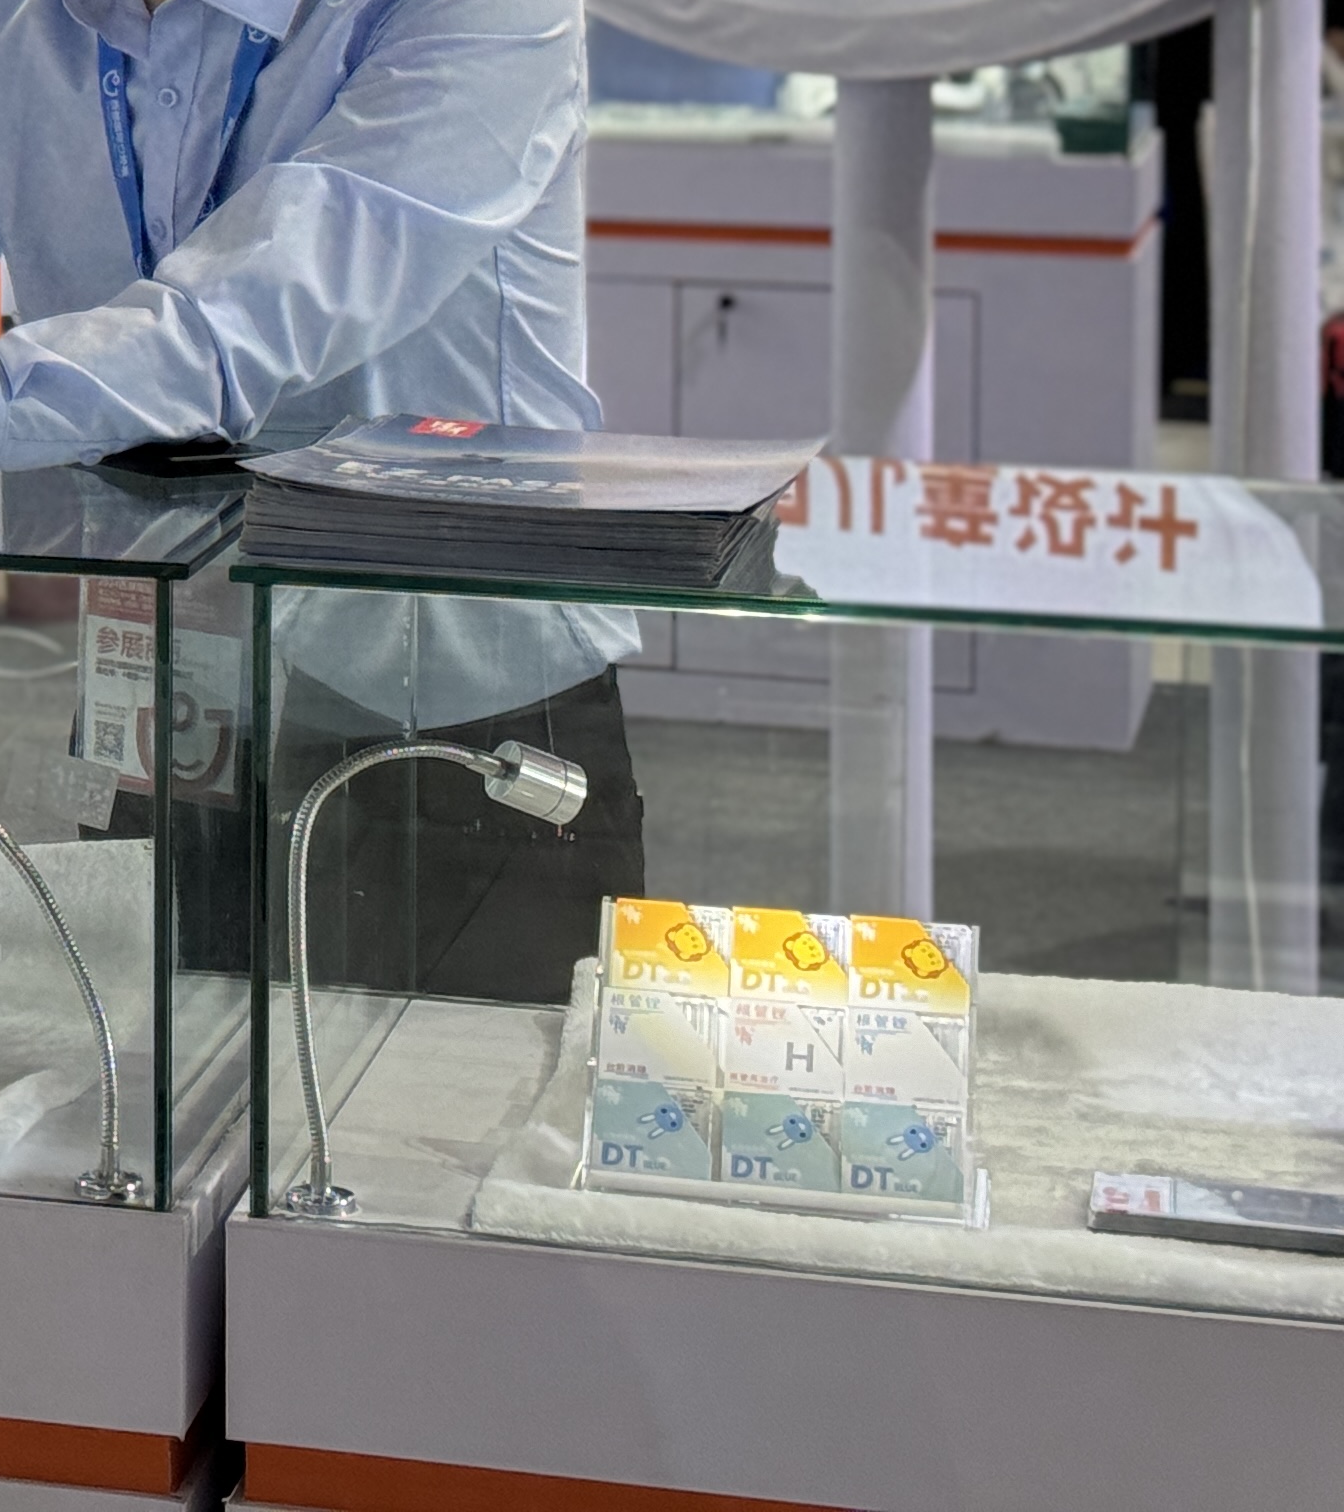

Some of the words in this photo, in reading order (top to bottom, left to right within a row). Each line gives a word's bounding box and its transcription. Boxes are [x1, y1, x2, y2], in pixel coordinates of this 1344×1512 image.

[622, 960, 660, 981] DT
[740, 970, 784, 992] DT
[860, 977, 903, 1001] DT
[785, 1041, 815, 1073] H
[601, 1141, 644, 1167] DT
[730, 1154, 773, 1180] DT
[850, 1164, 894, 1190] DT
